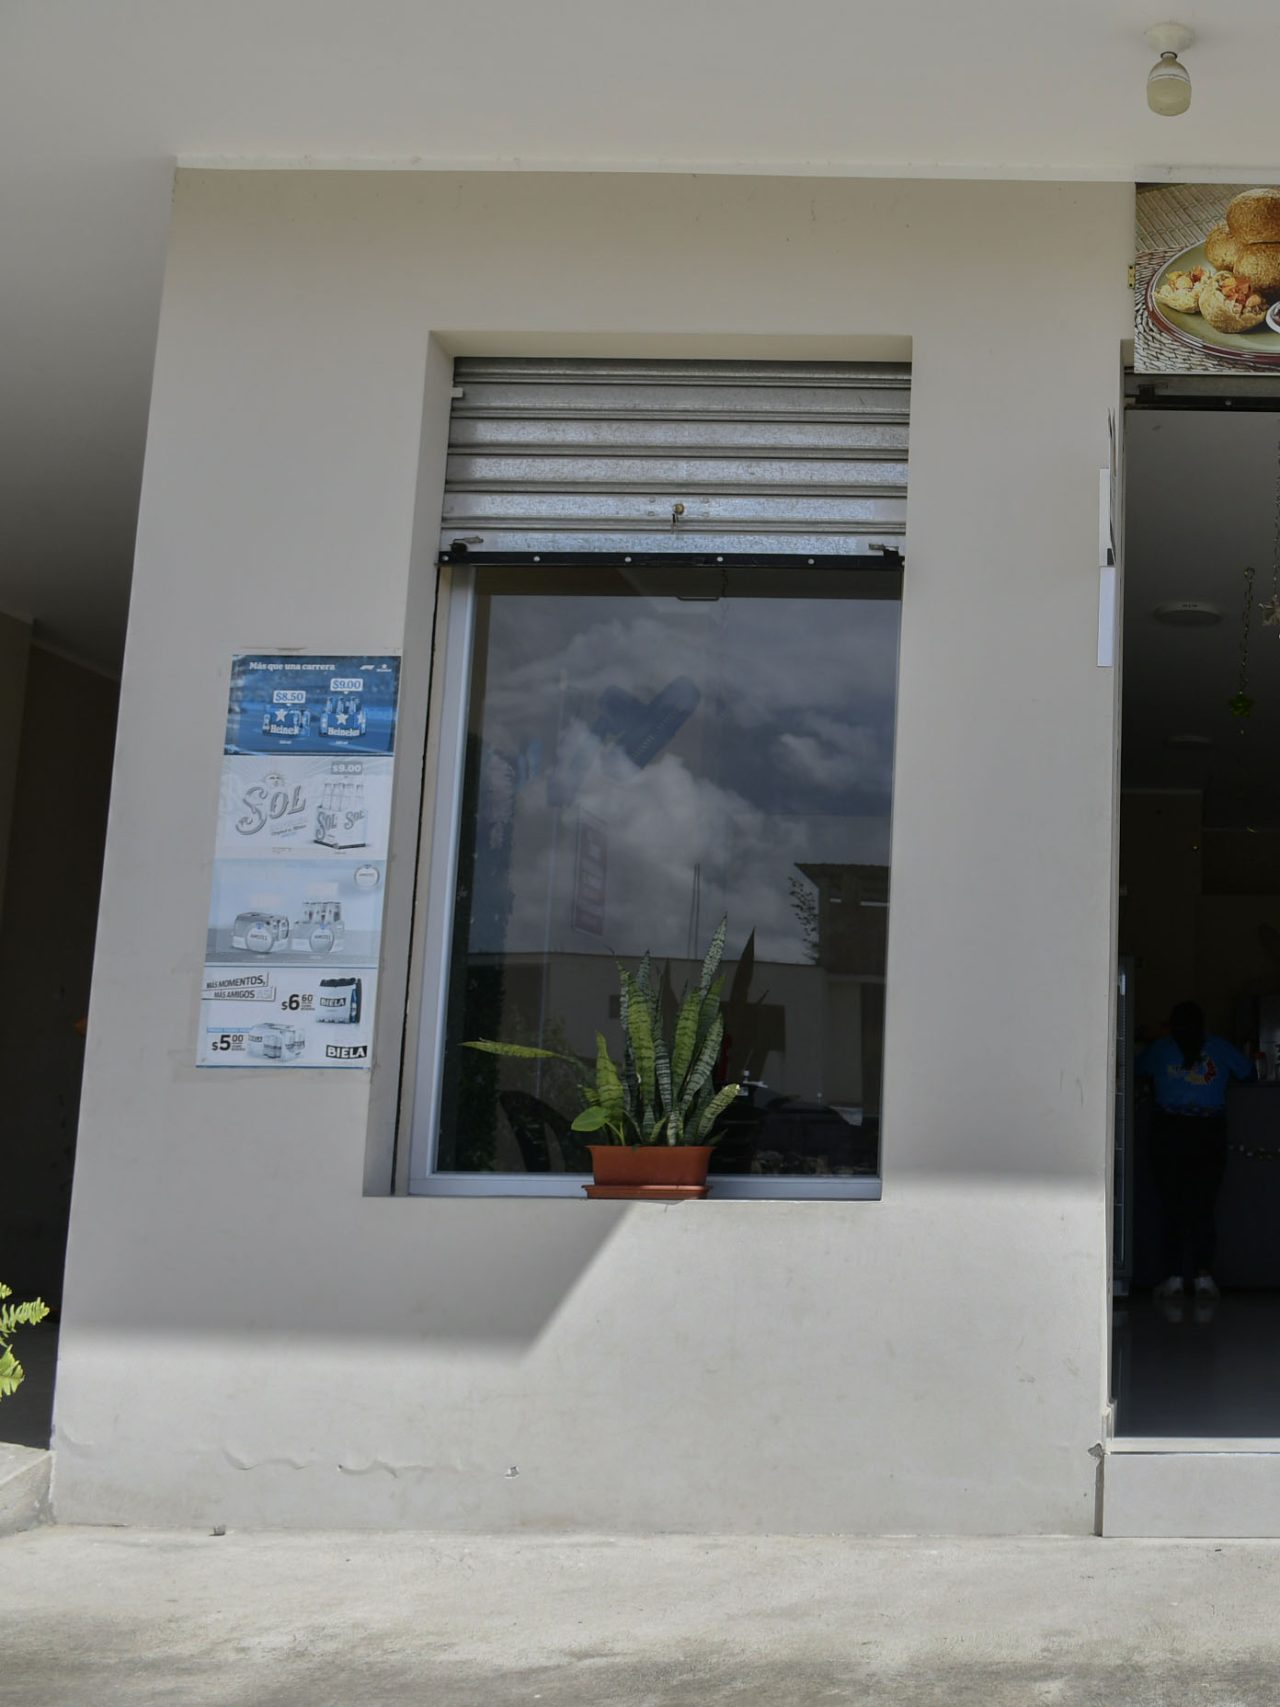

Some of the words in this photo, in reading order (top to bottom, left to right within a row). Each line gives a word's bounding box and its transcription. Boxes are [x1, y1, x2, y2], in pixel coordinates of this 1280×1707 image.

[249, 661, 266, 670] Más
[267, 663, 283, 672] que
[302, 663, 336, 671] carrera
[332, 679, 362, 690] $9.00
[275, 691, 304, 702] $8.50
[332, 763, 362, 773] $9.00
[218, 974, 266, 988] MOMENTOS,
[227, 989, 256, 999] AMIGOS
[321, 998, 345, 1007] BIELA
[327, 1046, 366, 1059] BIELA
